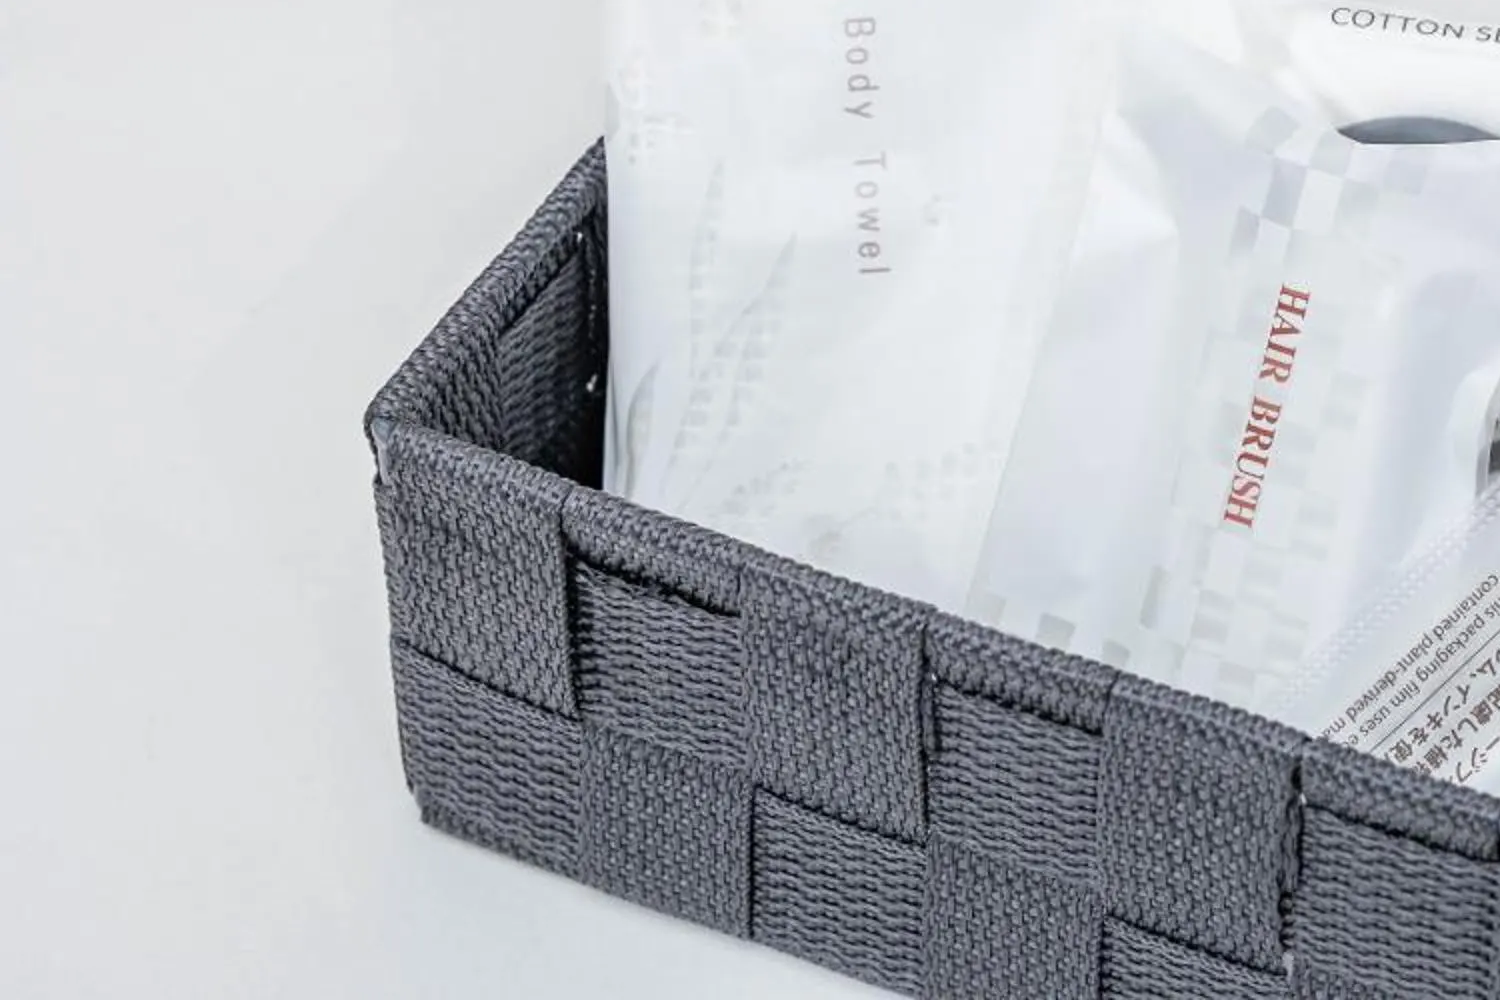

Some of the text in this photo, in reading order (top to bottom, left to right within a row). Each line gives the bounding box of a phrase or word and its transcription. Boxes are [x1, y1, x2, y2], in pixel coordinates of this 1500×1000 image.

[1331, 7, 1465, 39] COTTON
[842, 16, 892, 275] Body Towel
[1223, 282, 1310, 528] HAIR BRUSH
[1432, 574, 1499, 641] contained
[1345, 632, 1434, 723] plant-derived
[1415, 613, 1485, 682] packaging
[1359, 704, 1391, 737] uses
[1391, 680, 1420, 708] film
